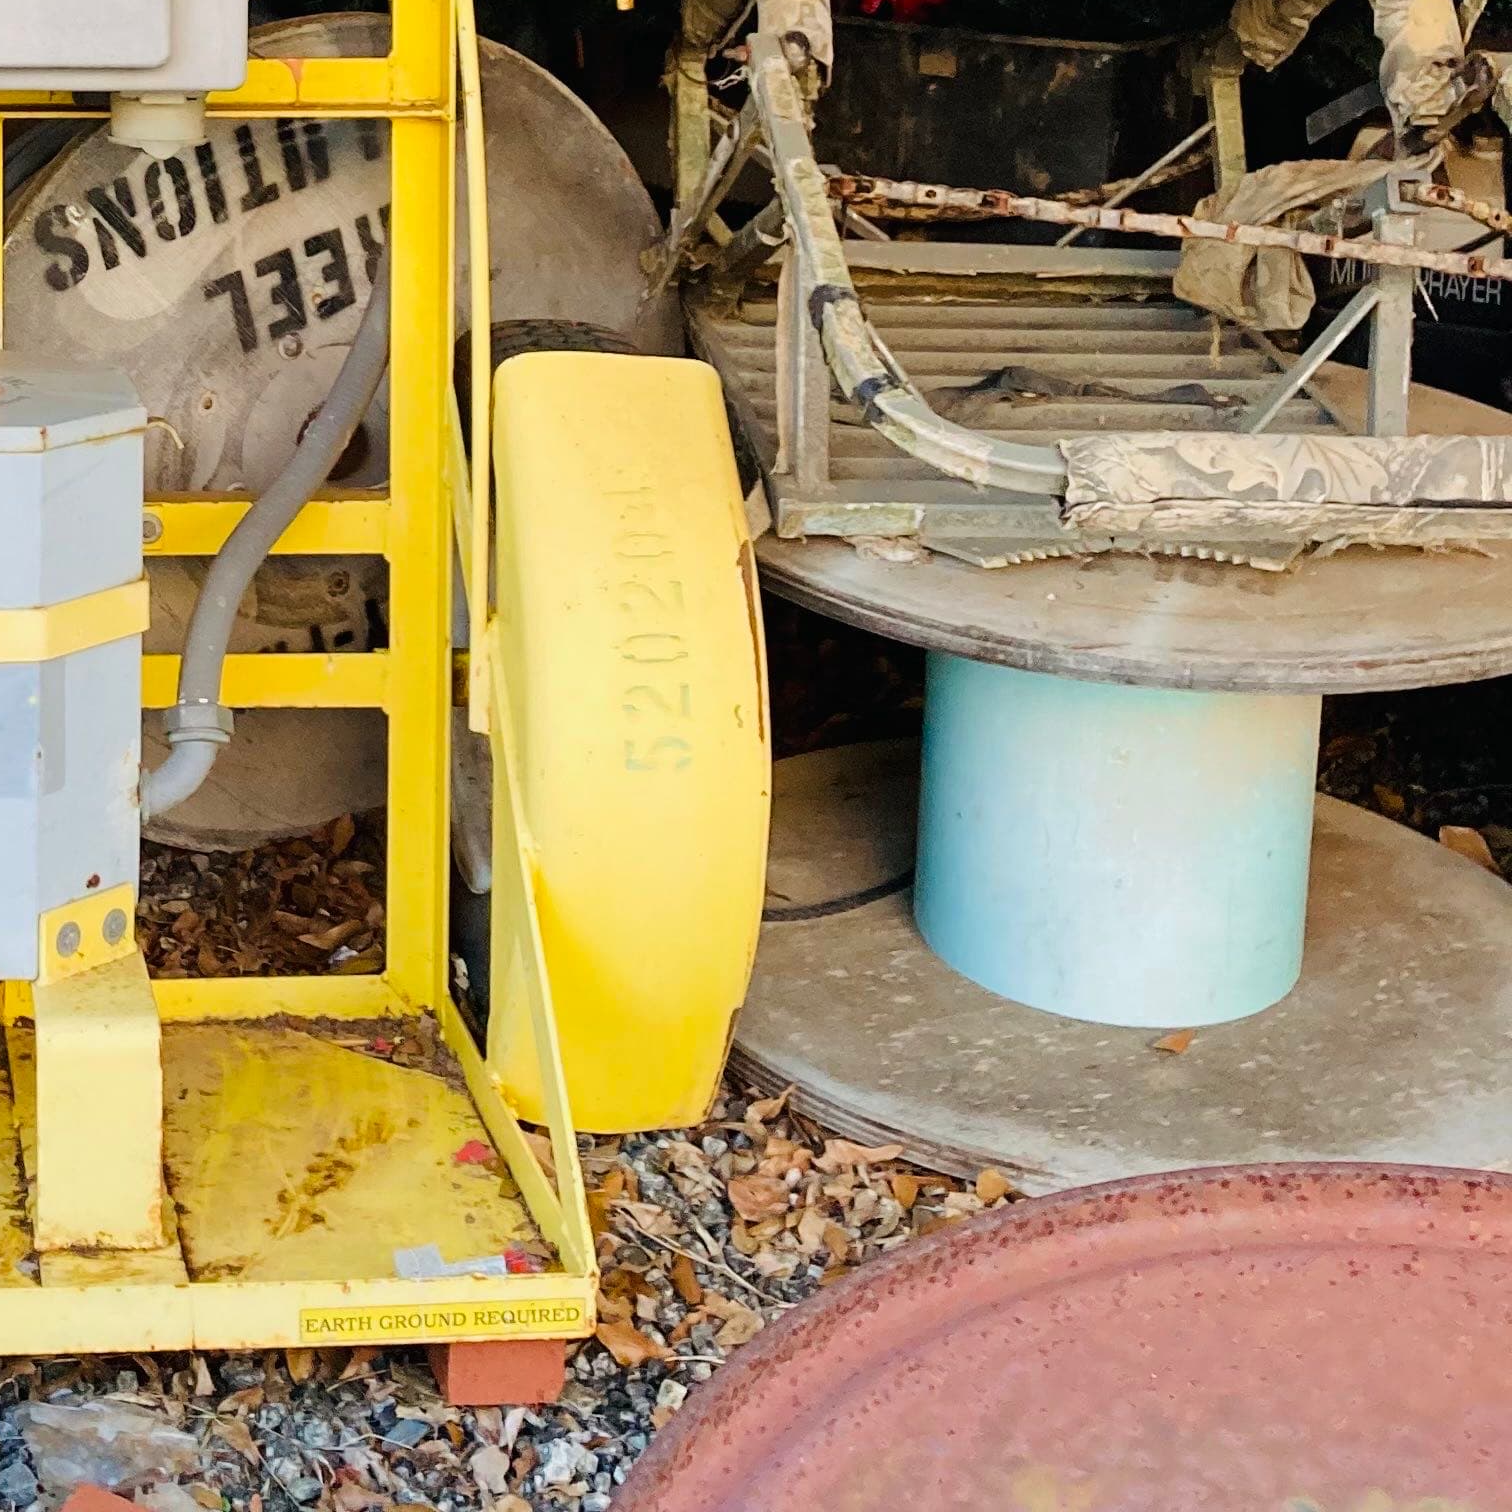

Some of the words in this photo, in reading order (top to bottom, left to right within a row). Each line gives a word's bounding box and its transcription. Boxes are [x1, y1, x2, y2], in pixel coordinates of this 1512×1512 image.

[306, 1316, 372, 1333] EARTH
[379, 1312, 467, 1331] GROUND
[474, 1306, 580, 1326] REQUIRED
